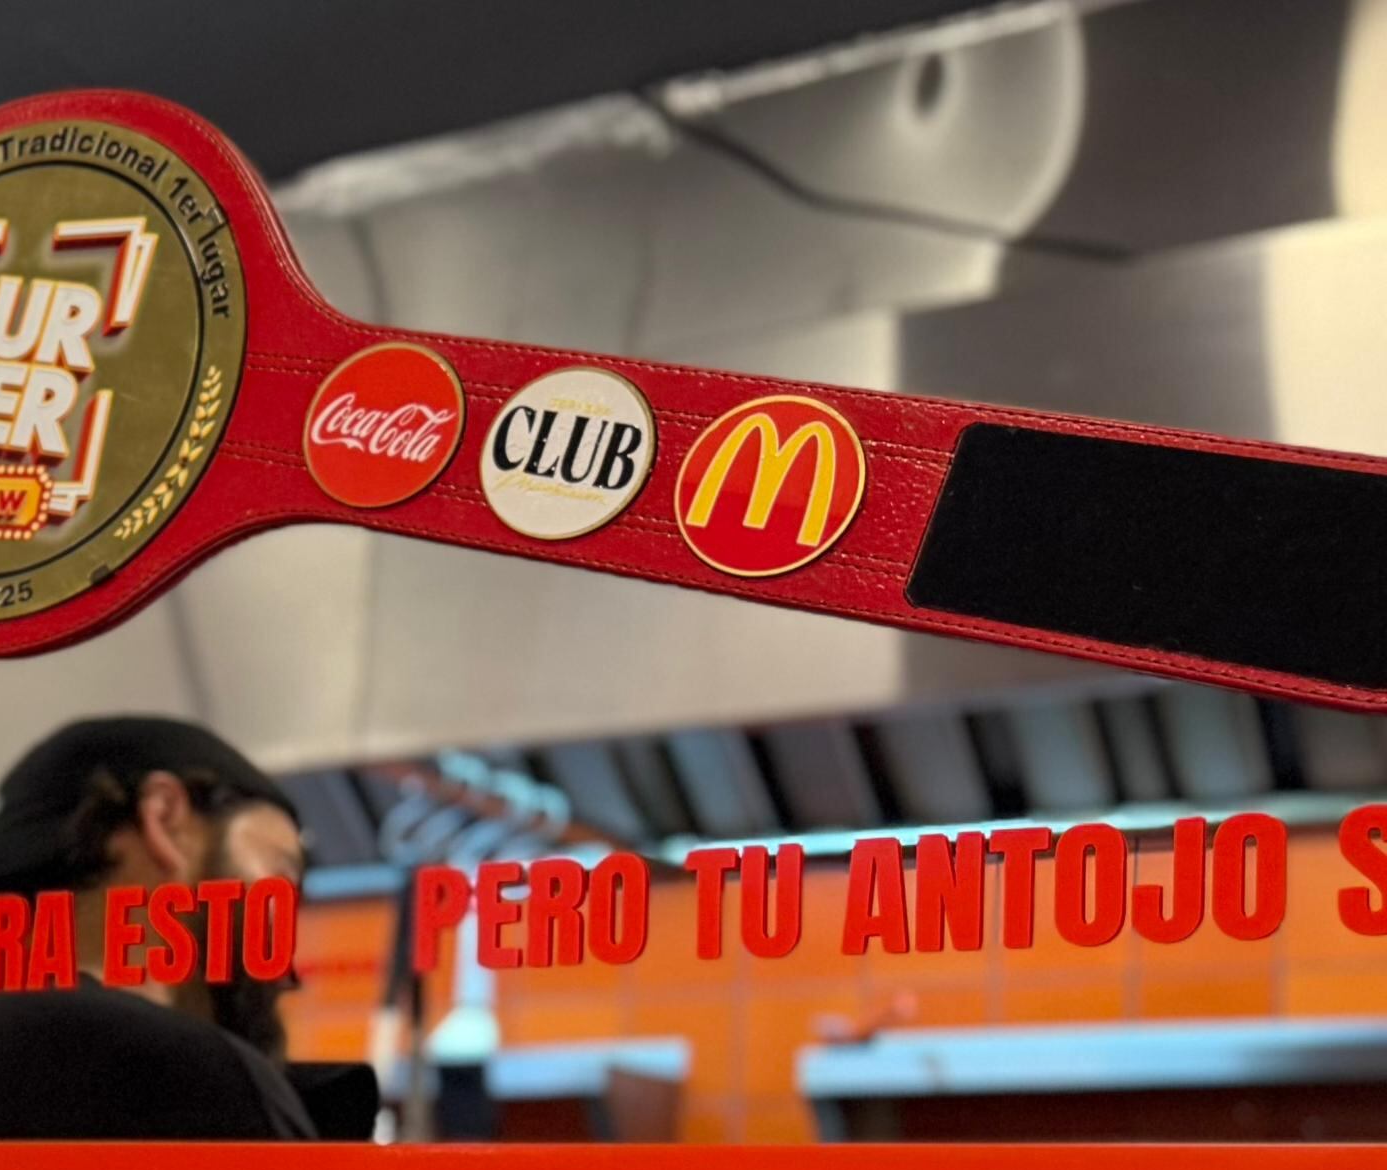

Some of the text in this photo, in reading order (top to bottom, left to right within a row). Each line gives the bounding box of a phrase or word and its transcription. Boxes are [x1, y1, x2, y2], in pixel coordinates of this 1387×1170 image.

[169, 177, 203, 224] 1er
[310, 392, 456, 464] Coca-Cola
[493, 405, 642, 490] CLUB
[103, 876, 299, 988] ESTO
[414, 851, 650, 969] PERO
[685, 842, 803, 959] TU
[840, 812, 1287, 956] ANTOJO
